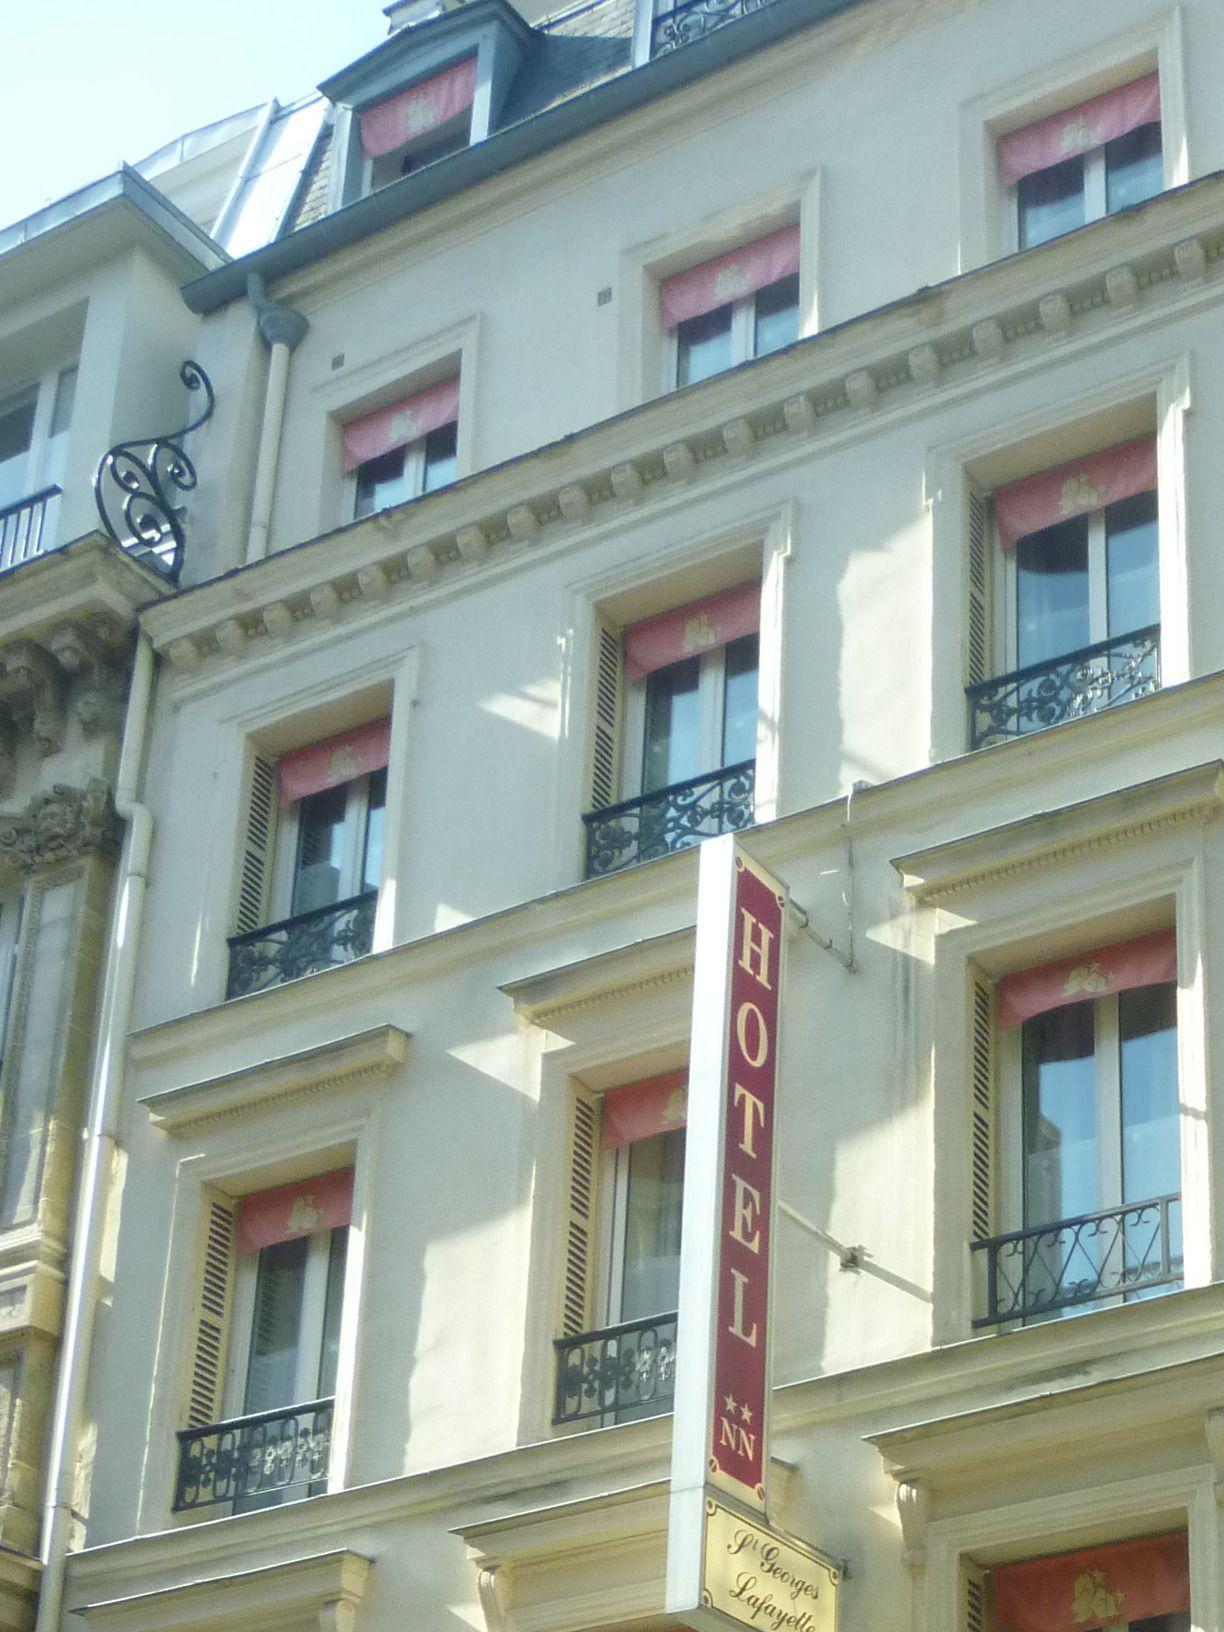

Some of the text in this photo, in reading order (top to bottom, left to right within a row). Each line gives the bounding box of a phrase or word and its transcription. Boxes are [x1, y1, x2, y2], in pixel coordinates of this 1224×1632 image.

[729, 906, 774, 1348] HOTEL
[720, 1416, 755, 1461] NN
[760, 1542, 819, 1600] Georges
